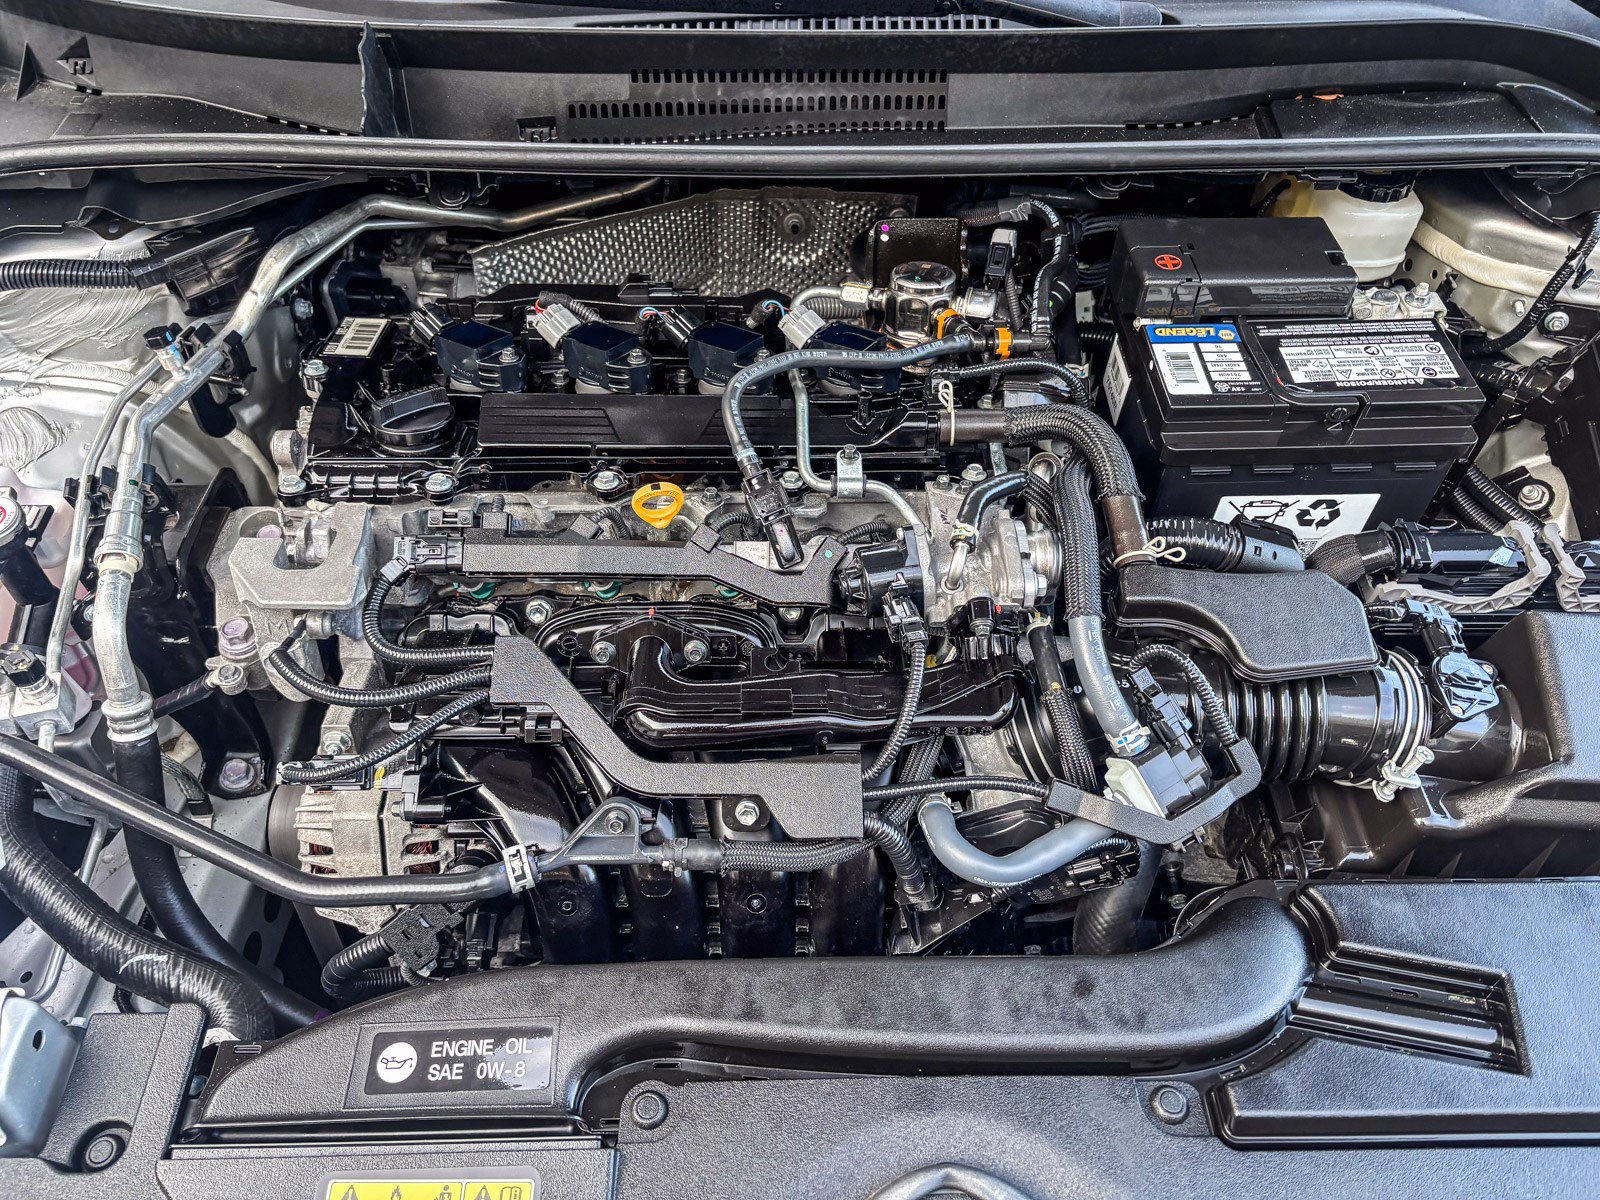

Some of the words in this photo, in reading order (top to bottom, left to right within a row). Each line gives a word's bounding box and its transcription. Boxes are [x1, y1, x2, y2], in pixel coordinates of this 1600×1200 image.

[1154, 327, 1215, 337] LEGEND
[1336, 379, 1415, 387] DANGER/POISON
[430, 1039, 494, 1058] ENGINE
[505, 1037, 532, 1055] OIL
[428, 1062, 464, 1081] SAE
[476, 1061, 526, 1080] 0W-8
